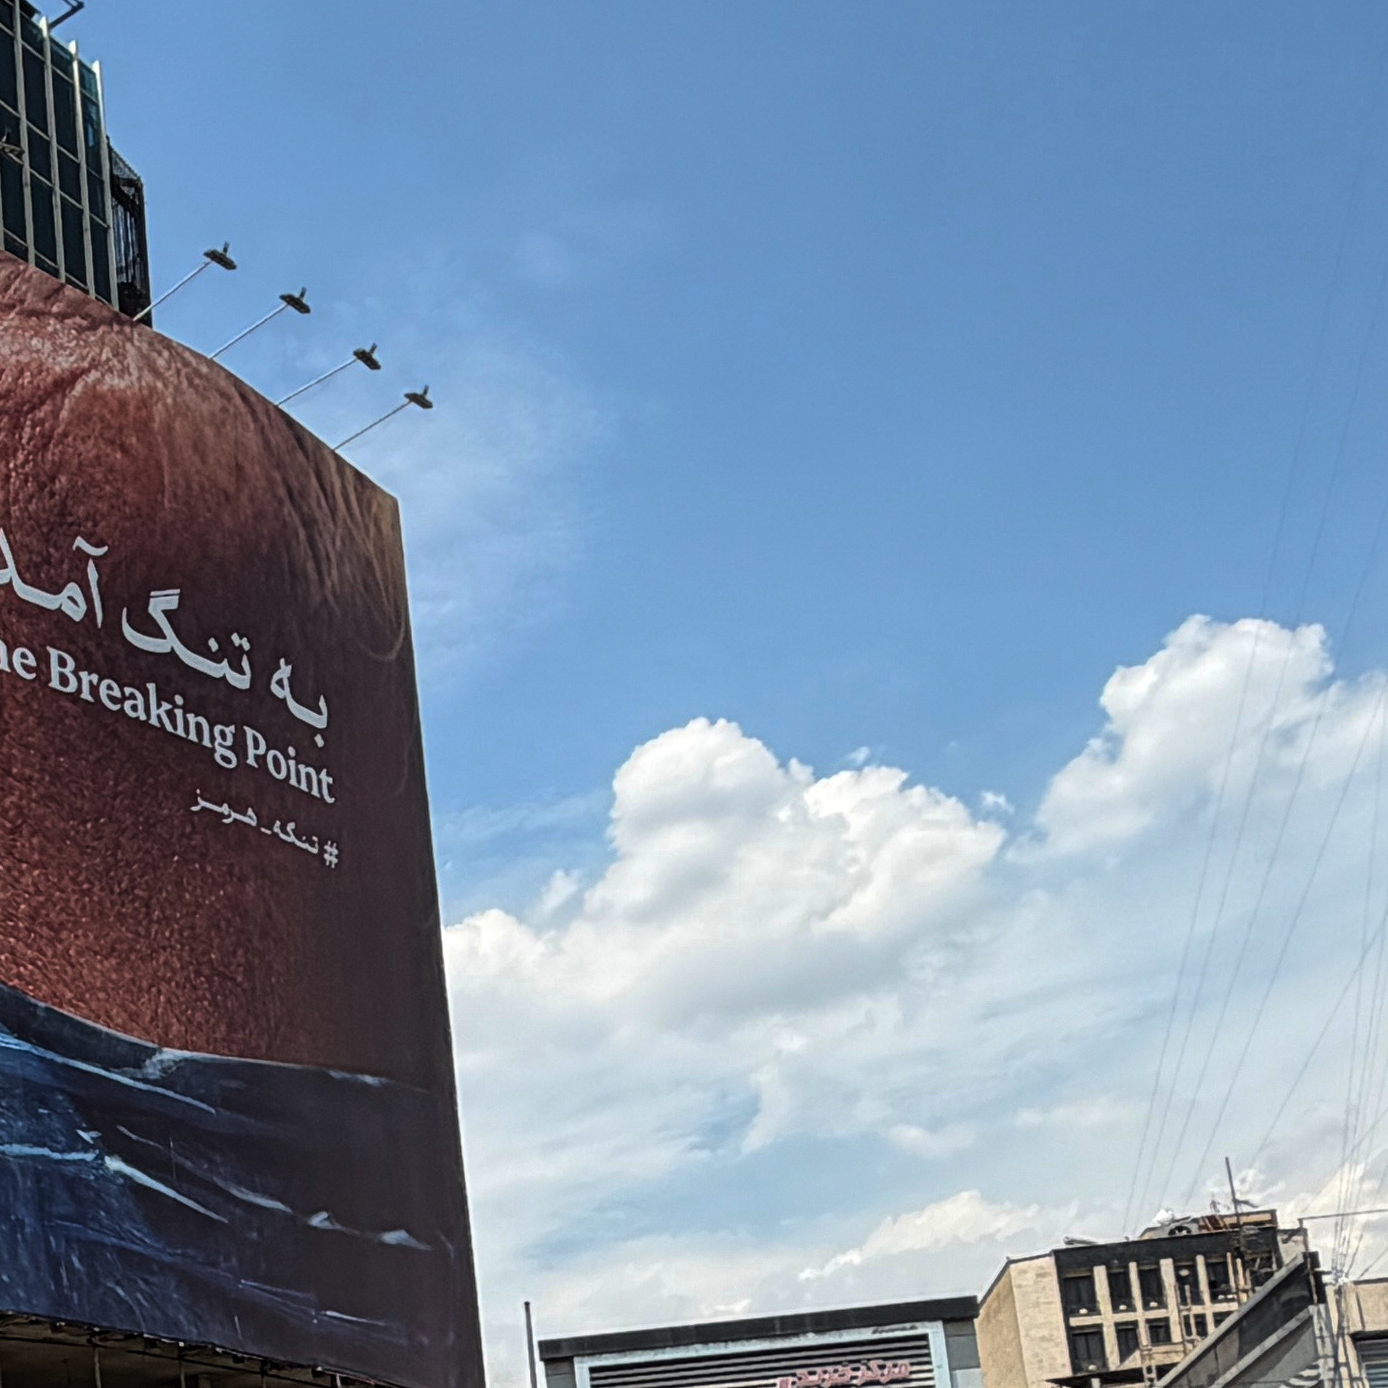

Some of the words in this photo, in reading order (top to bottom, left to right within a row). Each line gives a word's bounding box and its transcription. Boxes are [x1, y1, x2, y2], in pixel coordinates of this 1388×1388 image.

[122, 588, 252, 690] تنگ
[46, 645, 239, 769] Breaking
[243, 725, 336, 804] Point
[269, 657, 329, 748] به
